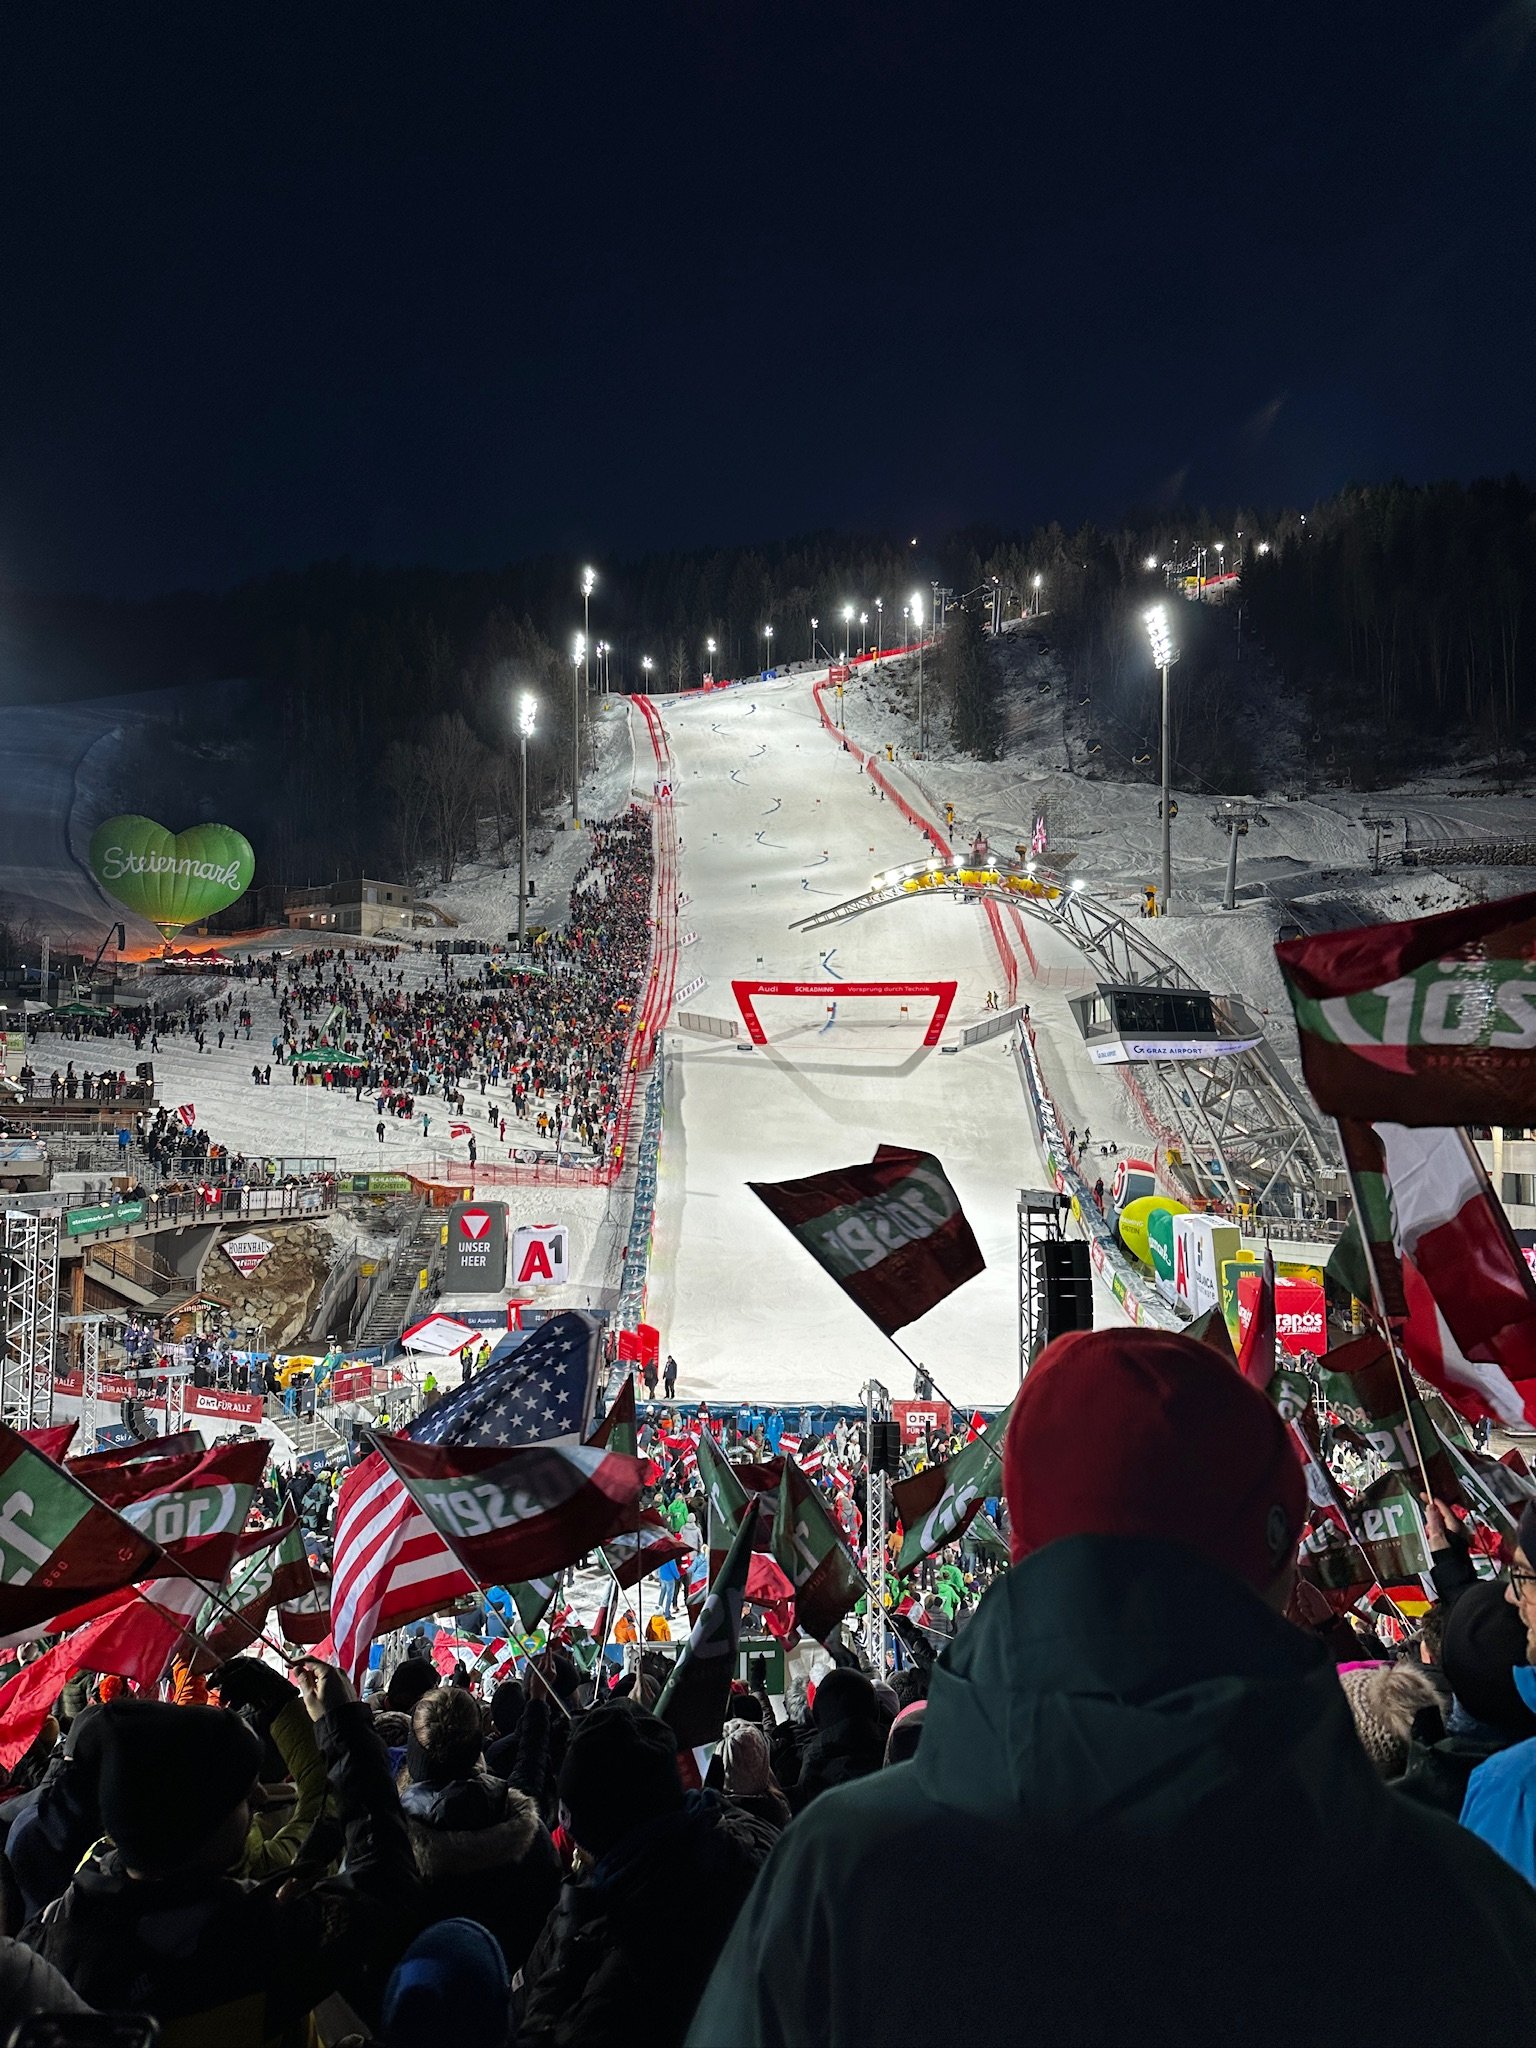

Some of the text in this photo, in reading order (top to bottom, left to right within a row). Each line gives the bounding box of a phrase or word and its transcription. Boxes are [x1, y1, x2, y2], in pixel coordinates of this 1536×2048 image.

[103, 847, 241, 891] Steiermark
[757, 985, 779, 993] Audi
[847, 986, 882, 994] Vorsprung
[883, 985, 904, 993] durch
[904, 985, 930, 993] Technik
[72, 1213, 115, 1226] steiermark.com
[228, 1241, 270, 1254] HOHENHAUS
[458, 1242, 491, 1253] UNSER
[460, 1256, 486, 1267] HEER
[517, 1234, 563, 1282] A1
[1297, 1325, 1322, 1333] DRINKS
[57, 1378, 75, 1388] ALLE
